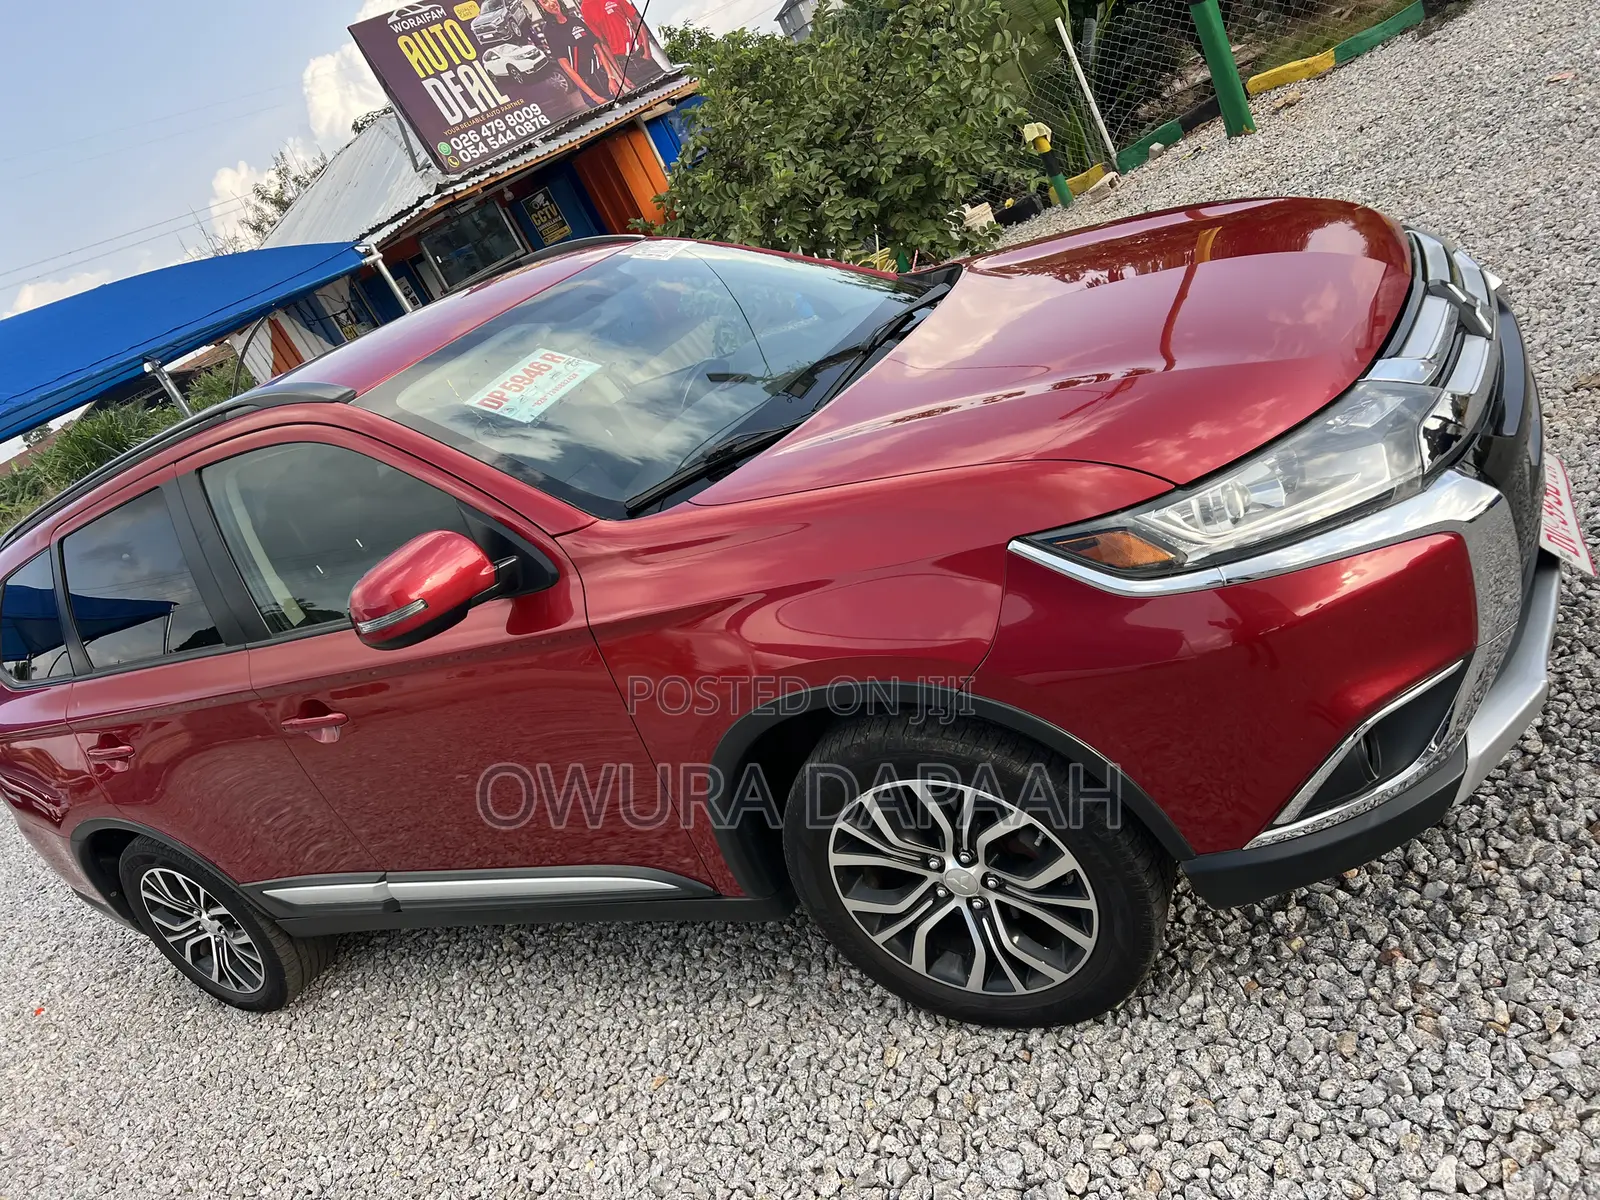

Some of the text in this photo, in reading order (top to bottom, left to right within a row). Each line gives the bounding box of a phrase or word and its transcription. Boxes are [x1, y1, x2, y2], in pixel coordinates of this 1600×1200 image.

[390, 7, 447, 33] WORAIFAM
[398, 19, 477, 78] AUTO
[421, 60, 511, 126] DEAL
[443, 98, 525, 136] YOUR RELIABLE AUTO PARTNER
[450, 103, 542, 151] 026 479 8009
[458, 114, 550, 162] 054 544 0878
[531, 203, 558, 226] CCTV
[476, 390, 511, 410] DP
[498, 361, 553, 393] 5946
[539, 352, 566, 364] R
